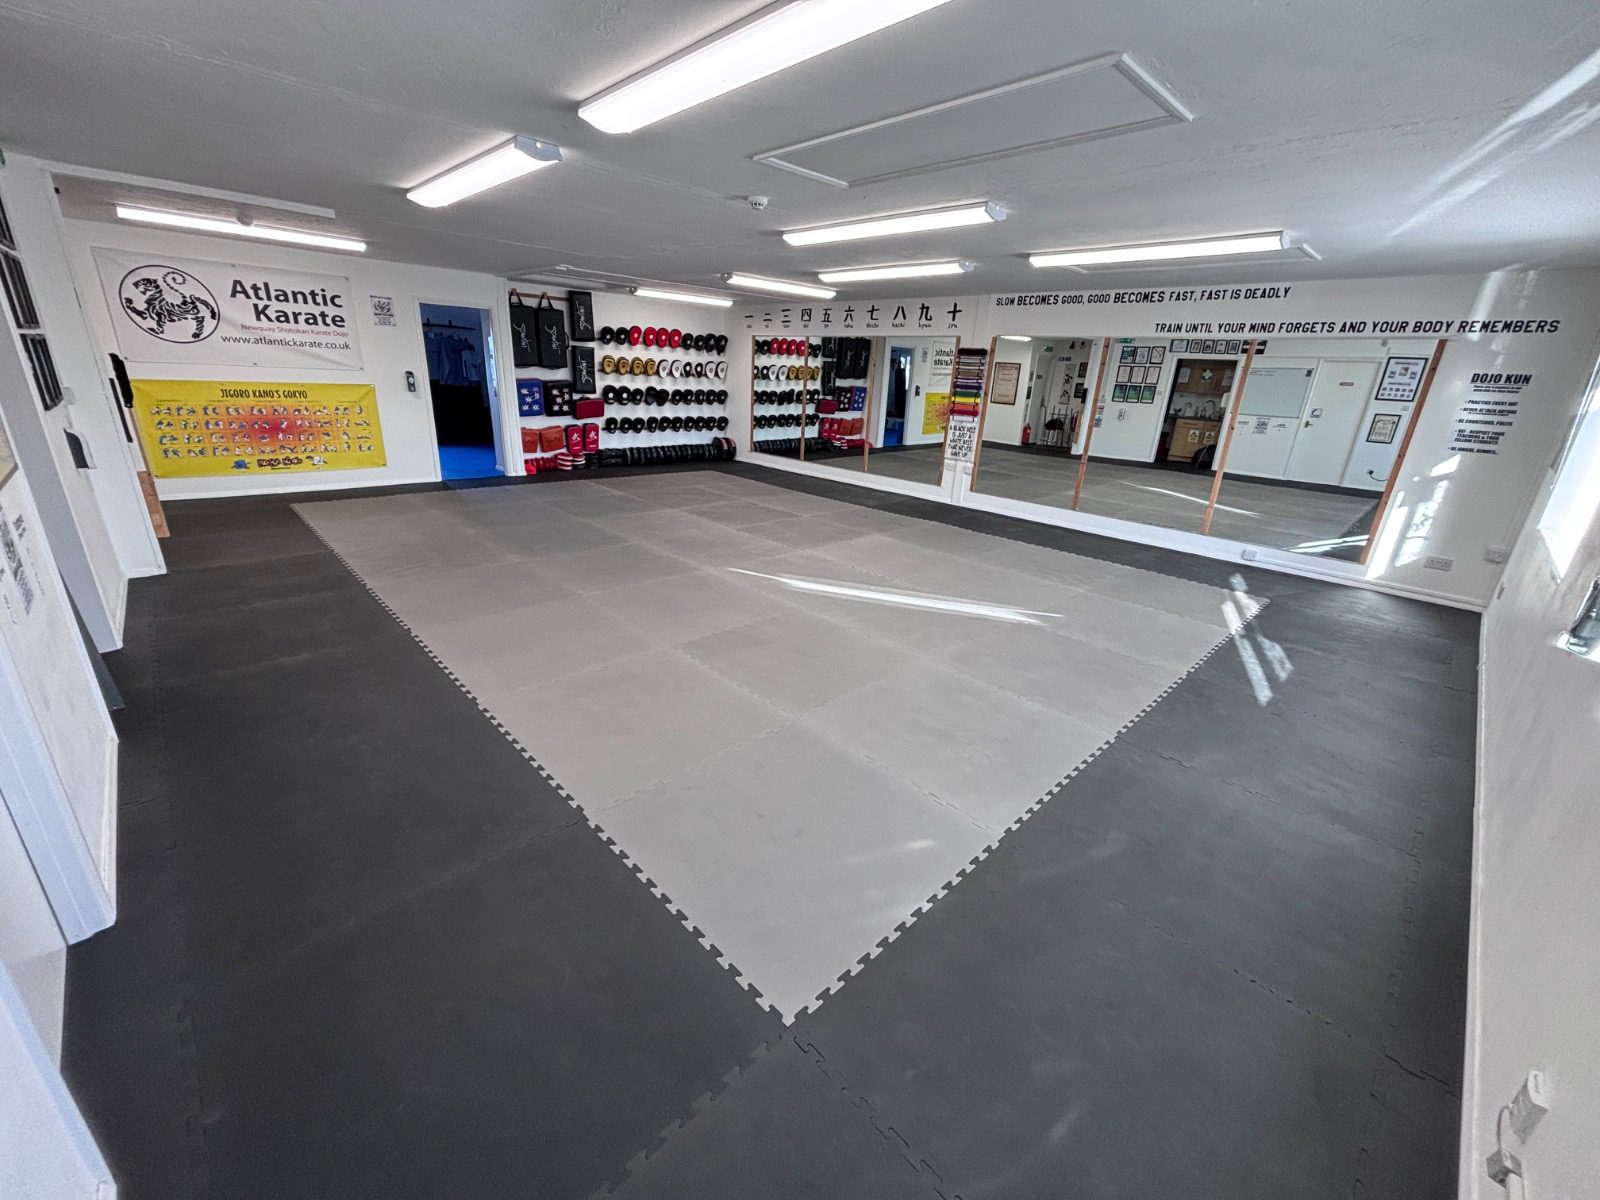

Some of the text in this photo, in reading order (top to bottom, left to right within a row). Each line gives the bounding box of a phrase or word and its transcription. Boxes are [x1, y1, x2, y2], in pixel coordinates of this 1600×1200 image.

[230, 279, 343, 308] Atlantic
[996, 286, 1291, 306] SLOW BECOMES GOOD, GOOD BECOMES FAST, FAST IS DEADLY
[252, 302, 346, 328] Karate
[781, 308, 791, 323] 三
[800, 308, 812, 322] 四
[821, 308, 832, 323] 五
[843, 305, 855, 323] 六
[866, 304, 880, 321] 七
[893, 305, 906, 321] 八
[918, 302, 932, 321] 九
[946, 302, 962, 322] 十
[241, 323, 349, 338] Newquay Shotokan Karate Dojo
[1155, 320, 1560, 334] TRAIN UNTIL YOUR MIND FORGETS AND YOUR BODY REMEMBERS
[221, 335, 351, 350] www.atlantickarate.co.uk
[1471, 373, 1533, 385] DOJO KUN
[220, 389, 308, 399] JIGORO KANO'S GOKYO
